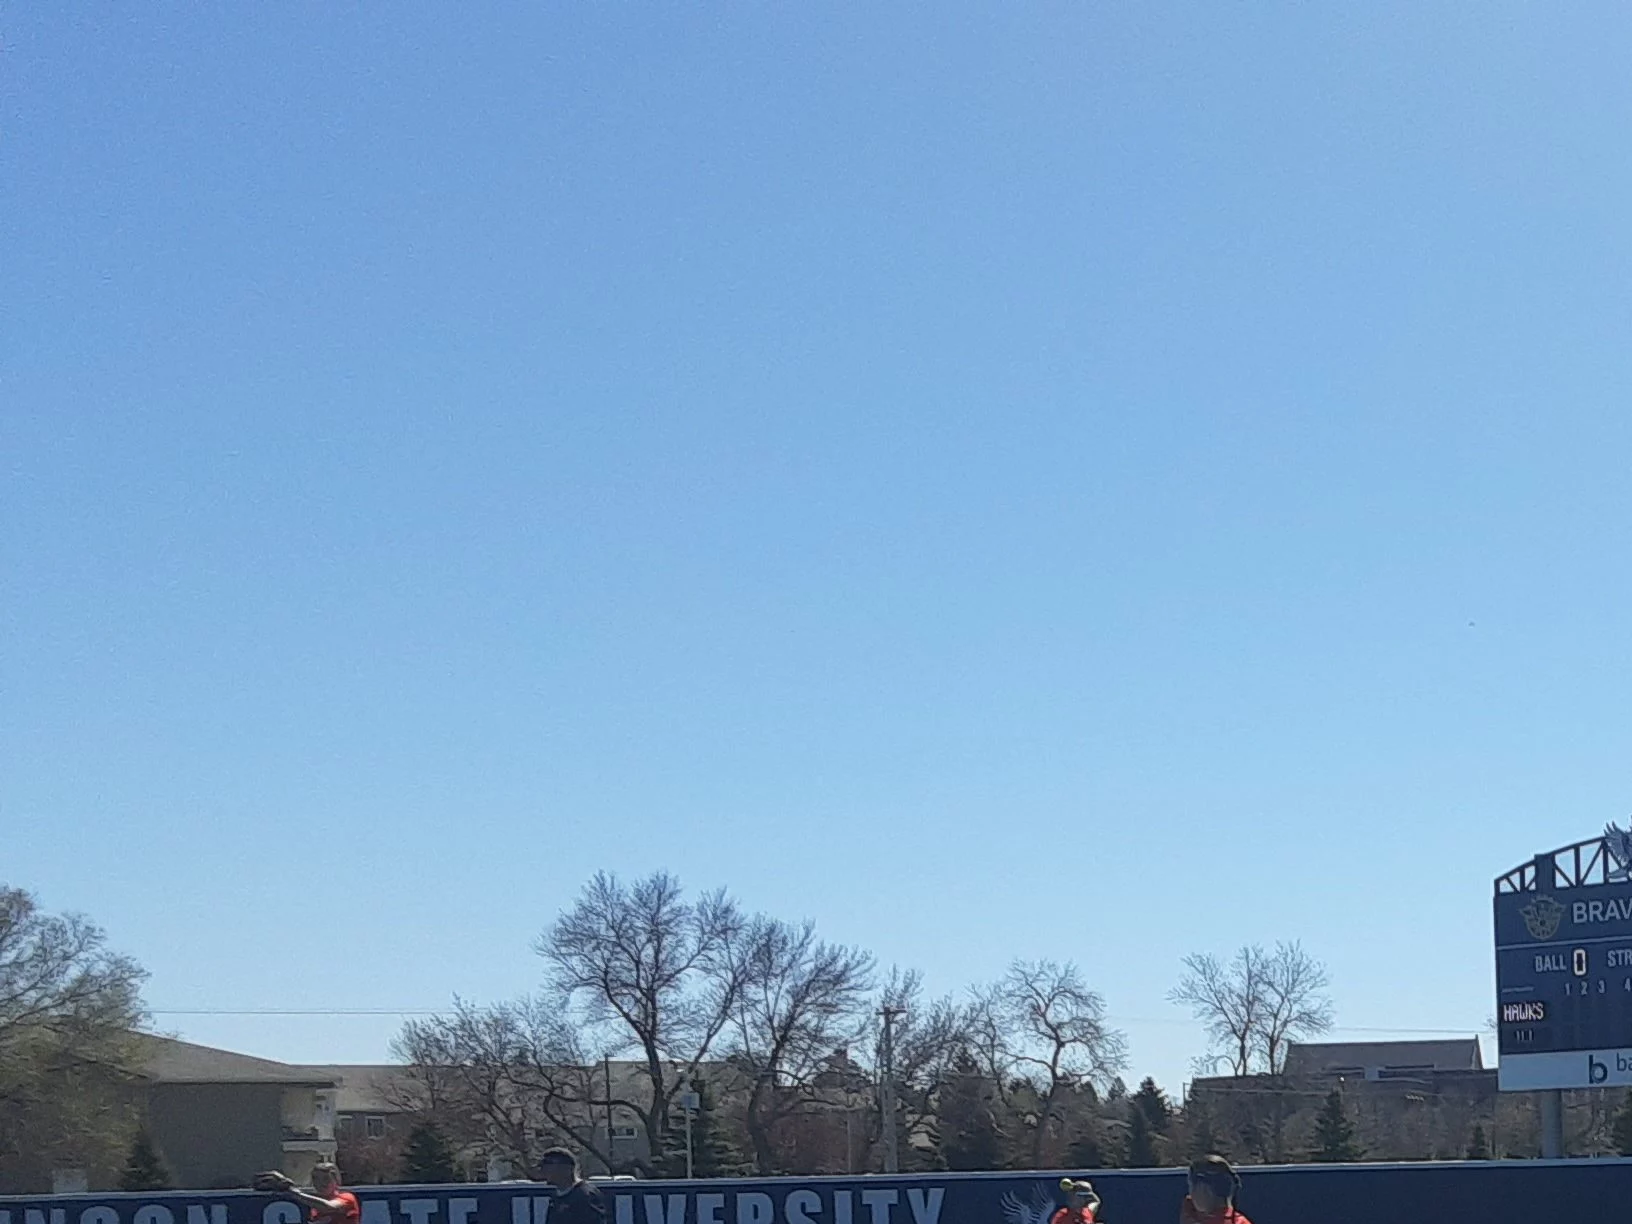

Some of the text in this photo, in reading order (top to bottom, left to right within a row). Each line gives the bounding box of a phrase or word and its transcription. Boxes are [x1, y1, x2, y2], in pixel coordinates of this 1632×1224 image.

[1535, 954, 1568, 973] BALL
[1573, 948, 1587, 976] 0
[1564, 982, 1572, 996] 1
[1580, 981, 1588, 996] 2
[1598, 980, 1606, 994] 3
[1624, 978, 1632, 992] 4
[1503, 1001, 1544, 1022] HAWKS
